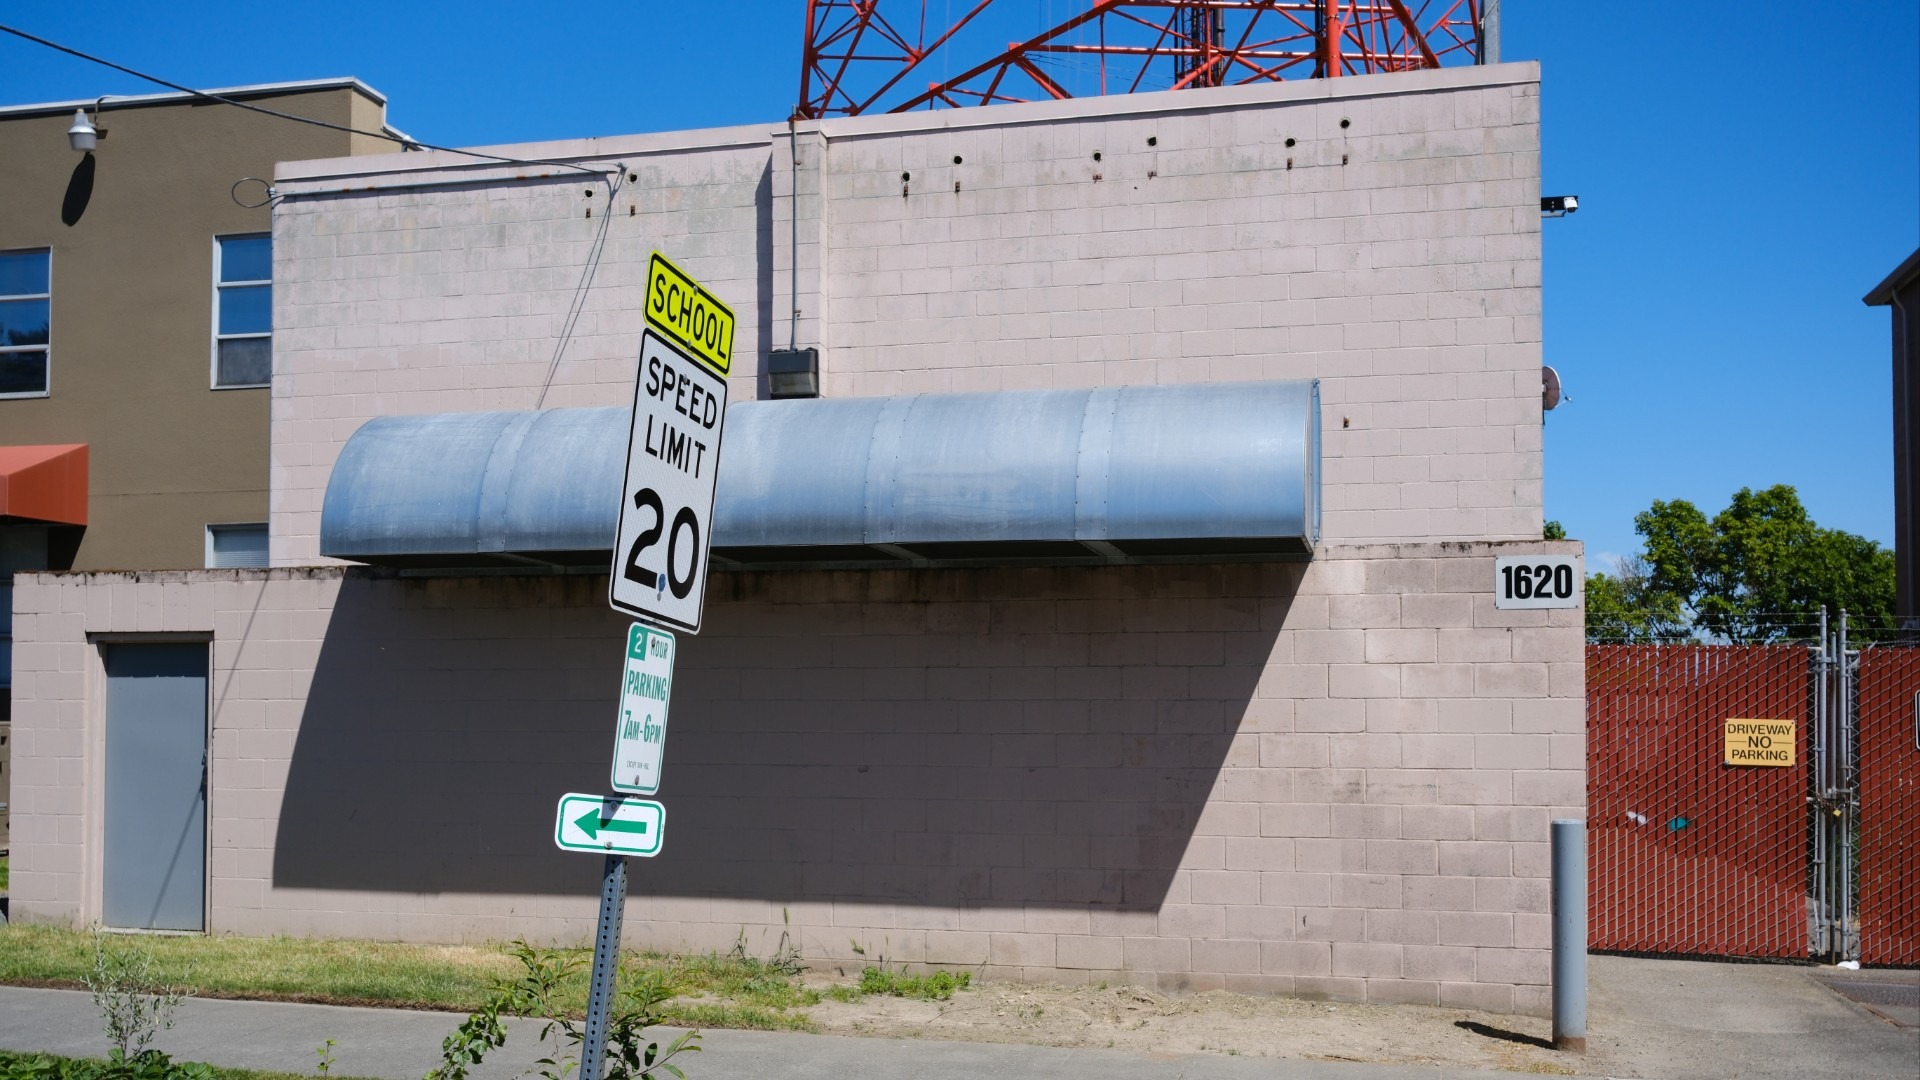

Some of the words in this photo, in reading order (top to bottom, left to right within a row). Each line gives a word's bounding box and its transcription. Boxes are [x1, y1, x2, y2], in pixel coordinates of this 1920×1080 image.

[653, 273, 727, 360] SCHOOL
[645, 356, 717, 430] SPEED
[645, 414, 706, 479] LIMIT
[624, 487, 700, 599] 20
[1501, 564, 1573, 599] 1620
[634, 632, 643, 653] 2
[627, 670, 667, 701] PARKING
[1727, 723, 1792, 735] DRIVEWAY
[1748, 735, 1772, 749] NO
[1731, 749, 1788, 761] PARKING
